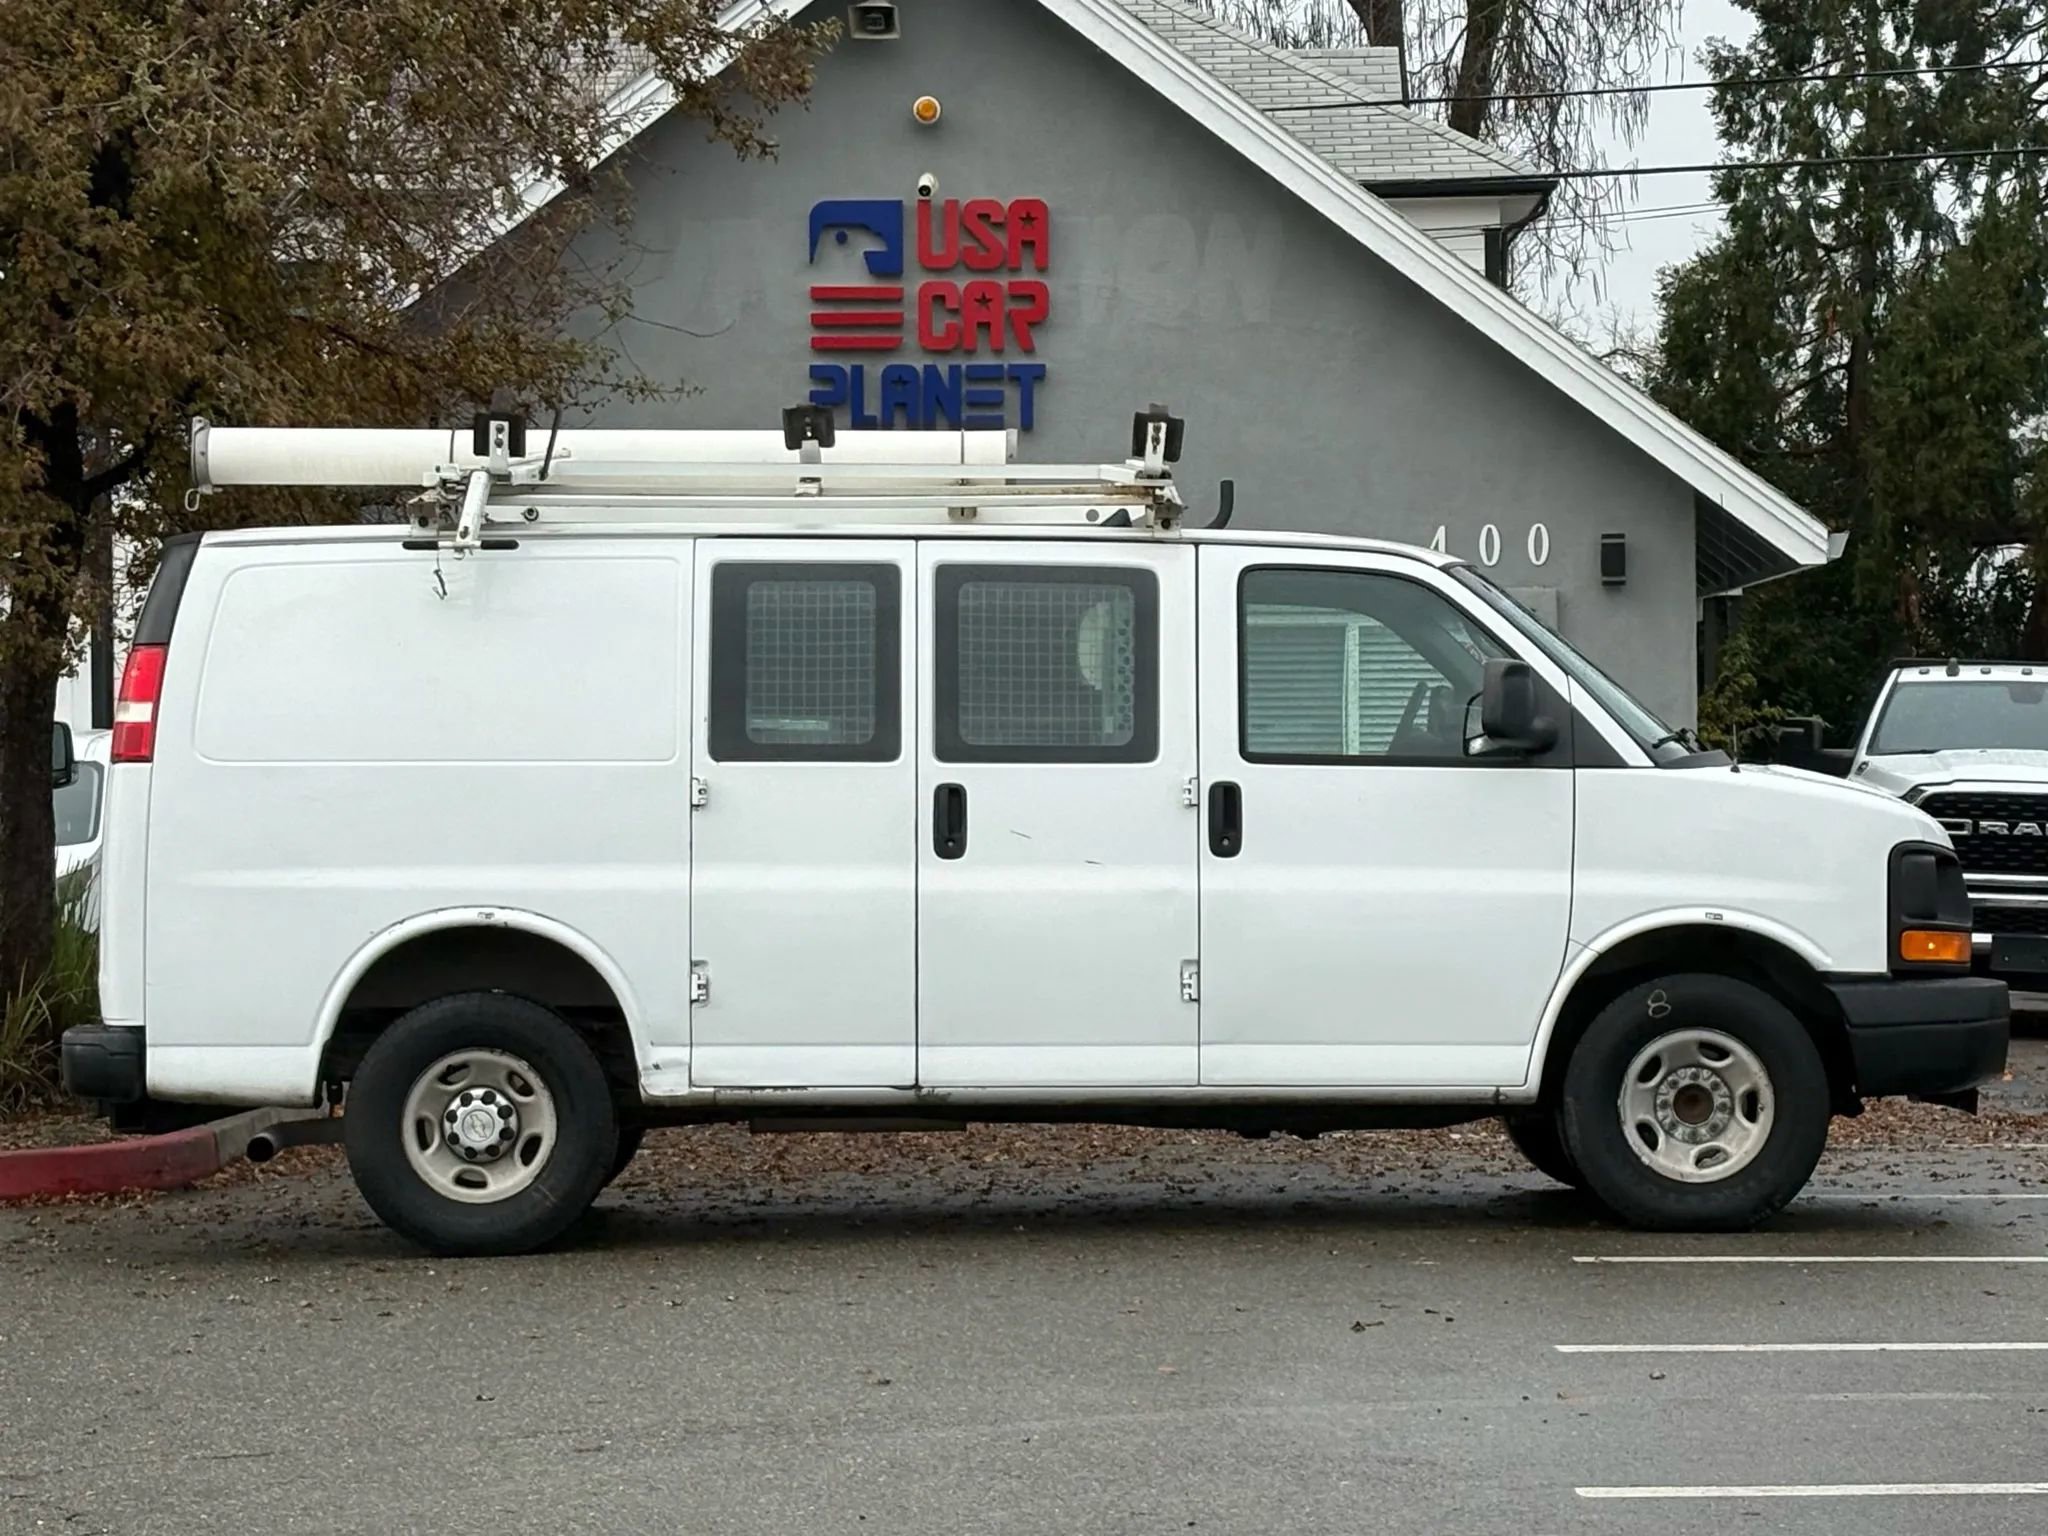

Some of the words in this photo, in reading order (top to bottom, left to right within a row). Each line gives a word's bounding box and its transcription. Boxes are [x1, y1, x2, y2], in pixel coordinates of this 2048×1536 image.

[917, 198, 1049, 270] USA
[917, 280, 1050, 351] CAR
[808, 363, 1047, 430] PLANET
[1979, 821, 2048, 836] RA
